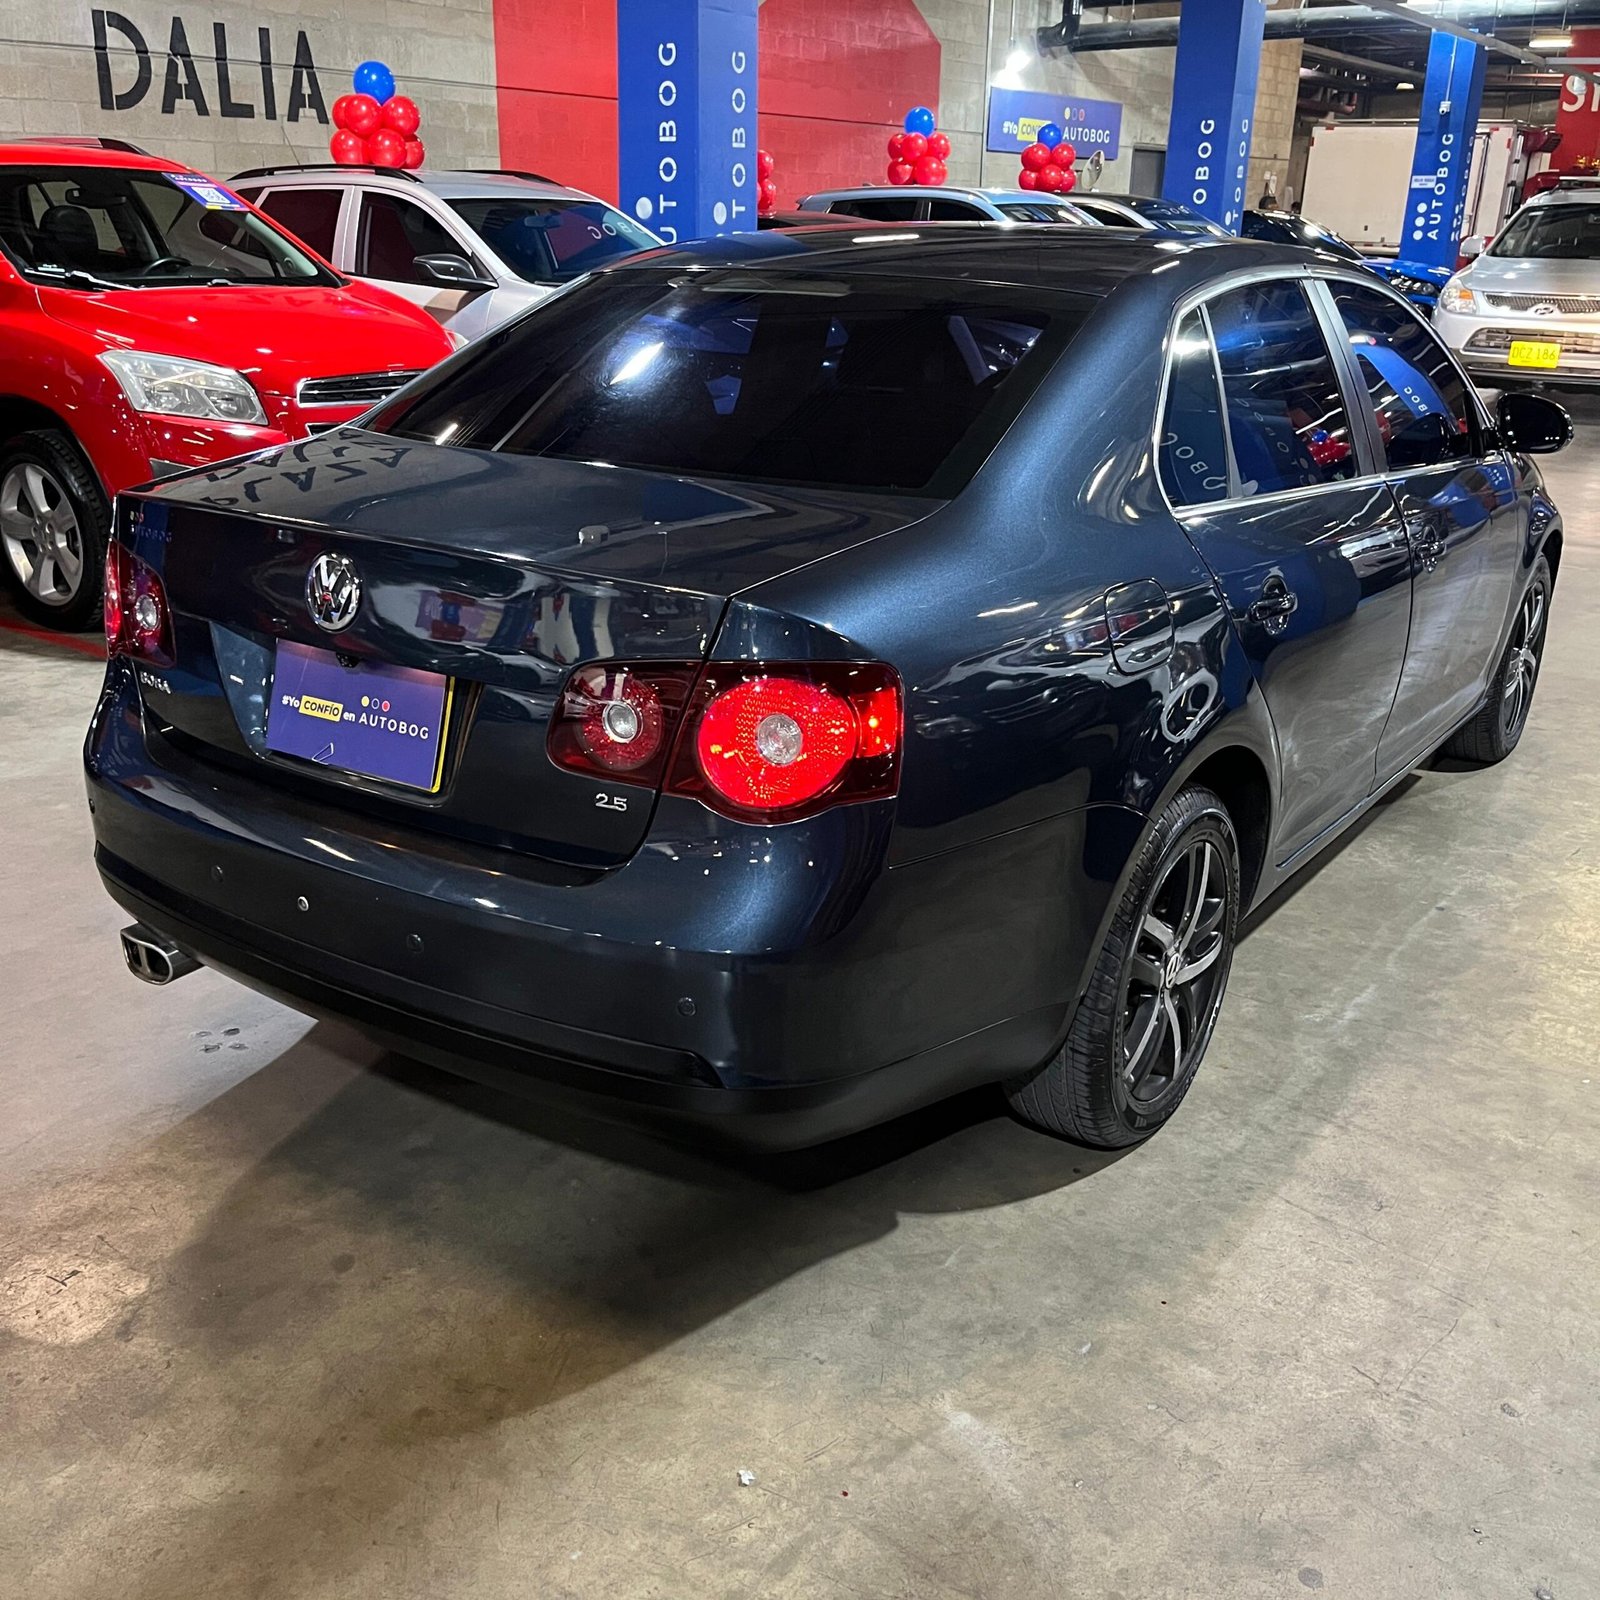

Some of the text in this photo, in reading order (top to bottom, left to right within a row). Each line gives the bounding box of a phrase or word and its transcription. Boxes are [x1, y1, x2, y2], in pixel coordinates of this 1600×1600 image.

[92, 9, 330, 125] DALIA
[732, 51, 746, 235] TOBOG
[1062, 126, 1110, 143] AUTOBOG
[1427, 133, 1454, 240] AUTOBOG
[1536, 348, 1556, 361] 186
[281, 695, 430, 740] #Yo CONFÍO en AUTOBOG
